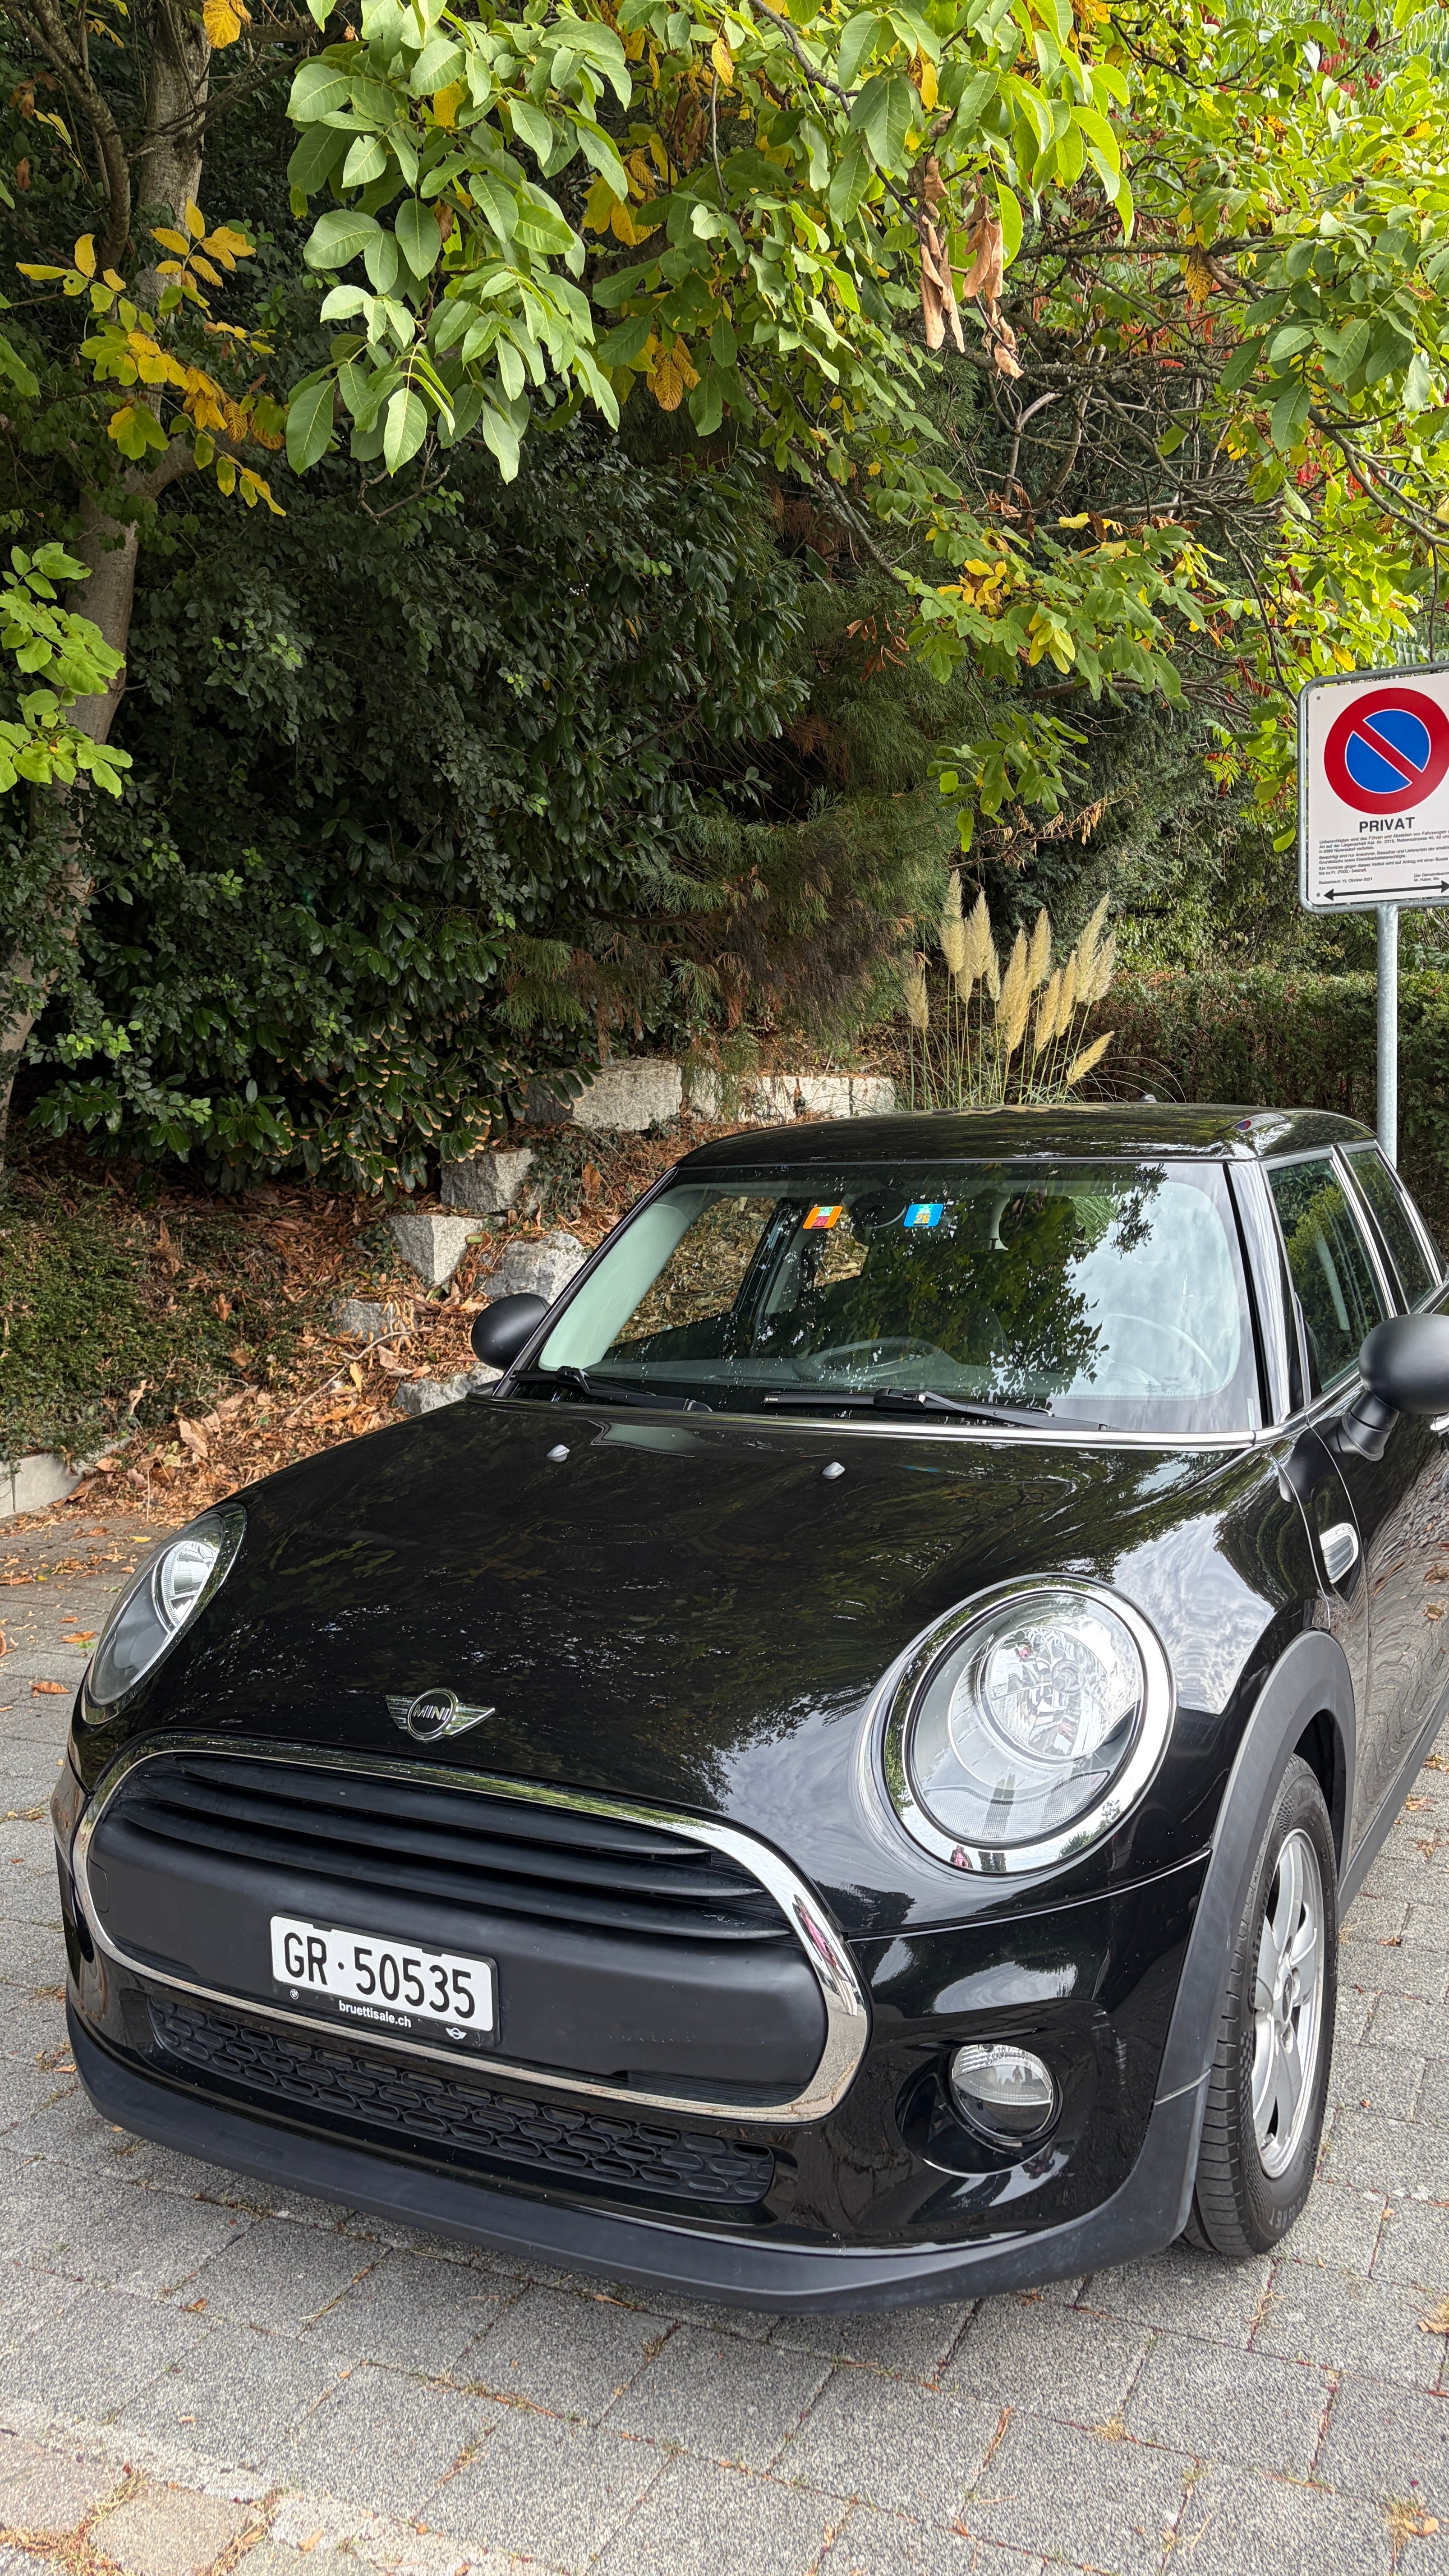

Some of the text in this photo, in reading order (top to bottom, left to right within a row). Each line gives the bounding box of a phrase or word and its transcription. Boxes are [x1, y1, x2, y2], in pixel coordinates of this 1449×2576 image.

[1359, 817, 1415, 833] PRIVAT
[413, 1704, 450, 1721] MINI
[284, 1932, 328, 1986] GR
[354, 1946, 475, 2019] 50535
[338, 2000, 412, 2028] bruettisale.ch
